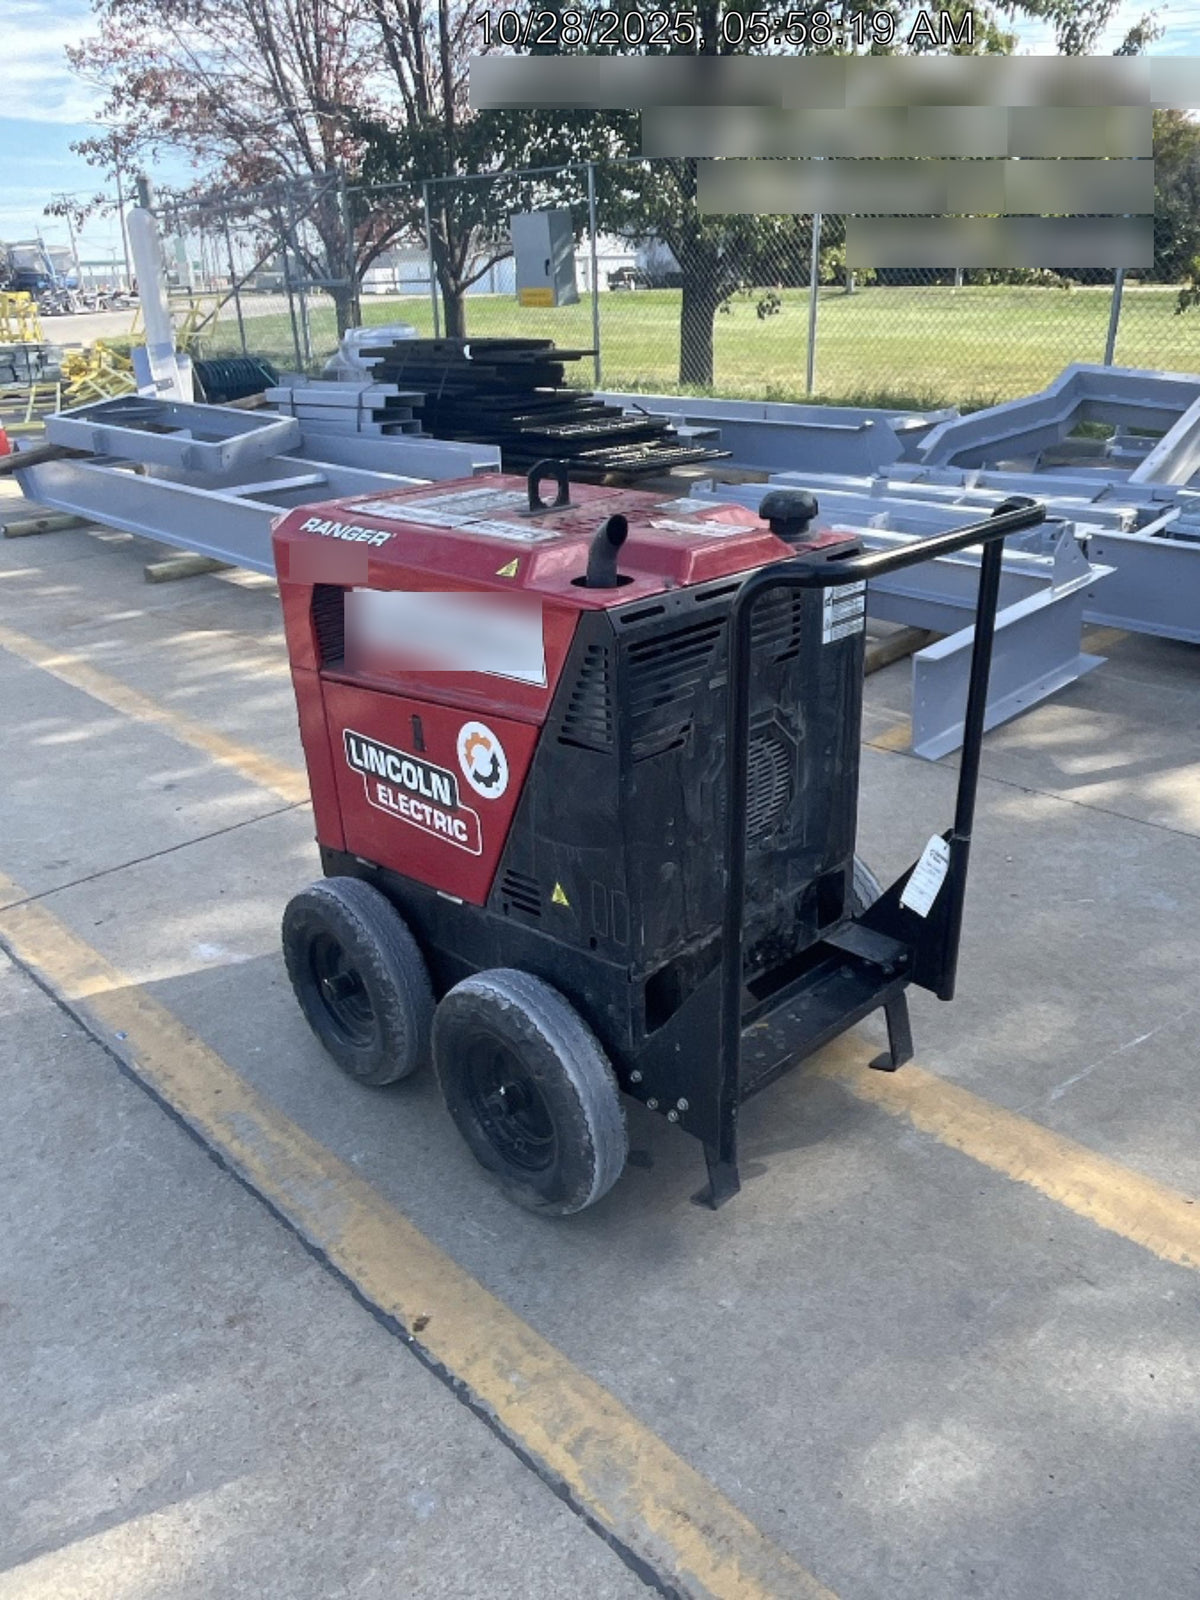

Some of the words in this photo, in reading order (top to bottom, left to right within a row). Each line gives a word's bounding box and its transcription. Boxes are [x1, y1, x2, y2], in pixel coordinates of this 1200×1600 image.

[299, 516, 392, 547] RANGER
[349, 737, 452, 807] LINCOLN
[376, 783, 469, 842] ELECTRIC
